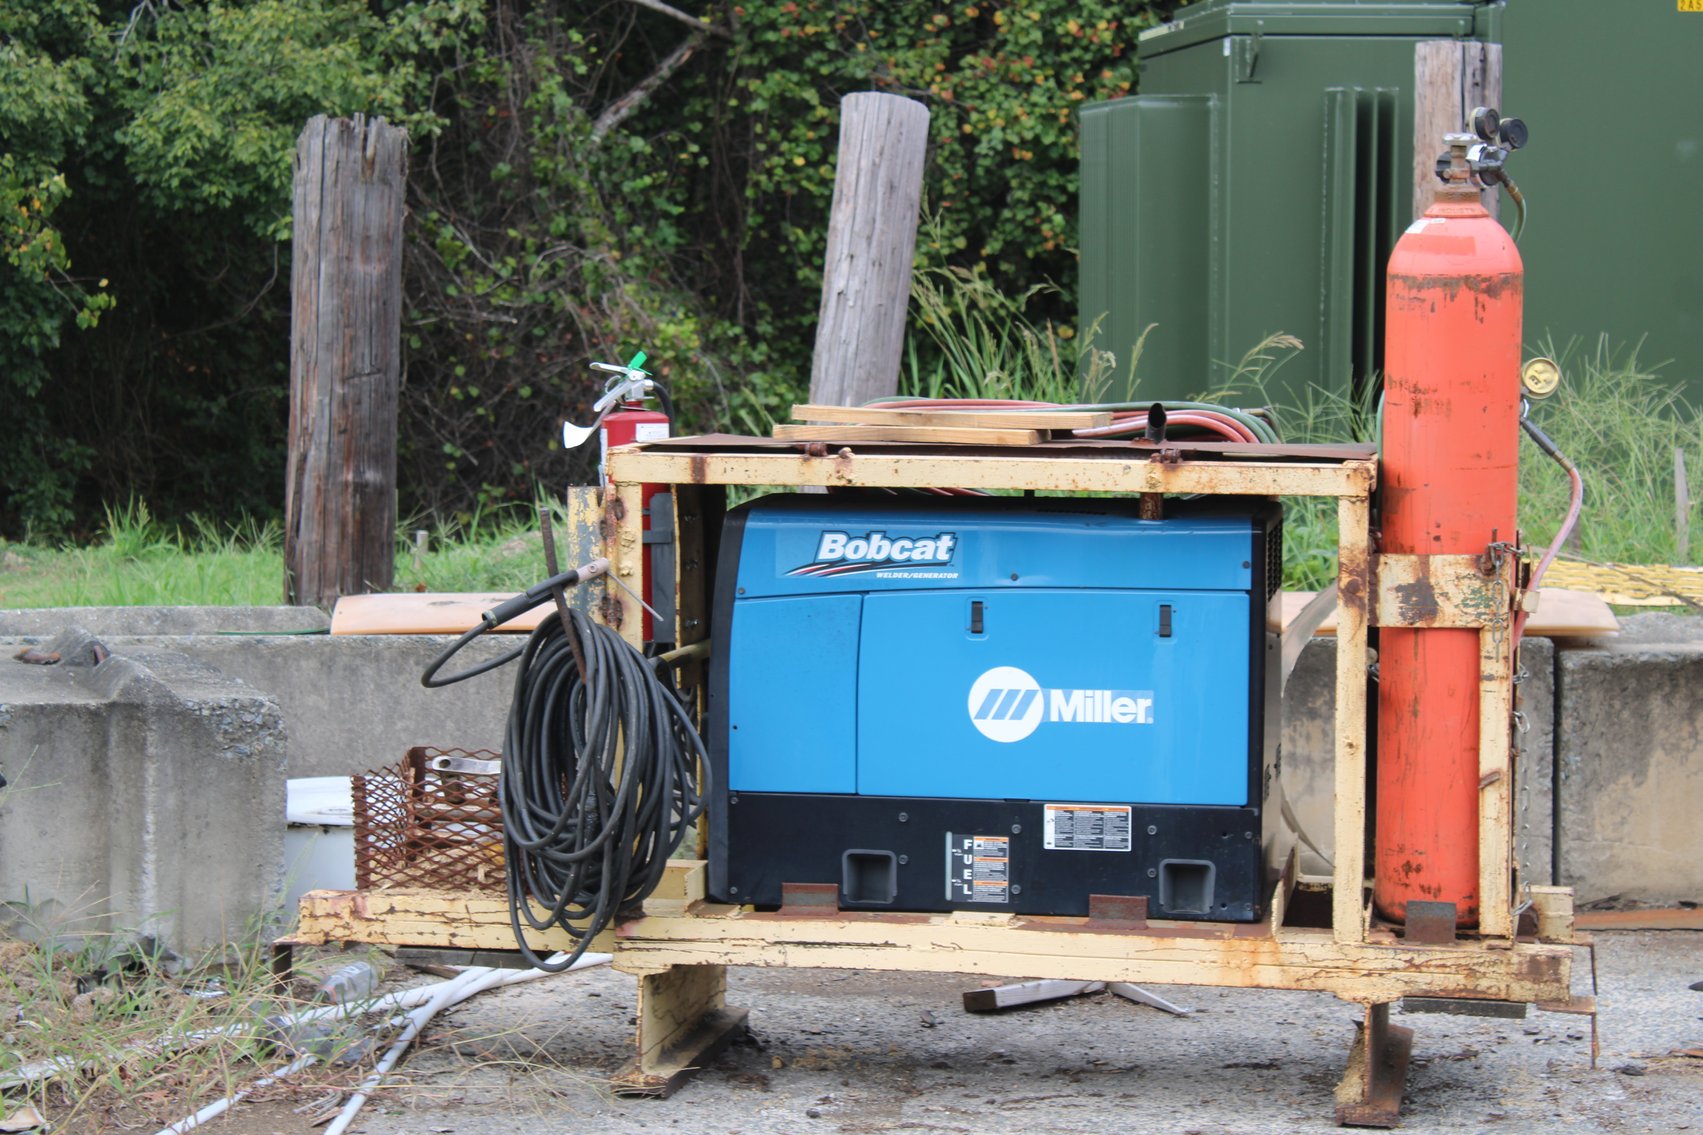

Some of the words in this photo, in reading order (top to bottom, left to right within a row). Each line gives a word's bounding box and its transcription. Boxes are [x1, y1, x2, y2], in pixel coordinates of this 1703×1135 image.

[816, 530, 957, 561] Bobcat
[1049, 688, 1152, 724] Miller
[963, 839, 973, 895] FUEL
